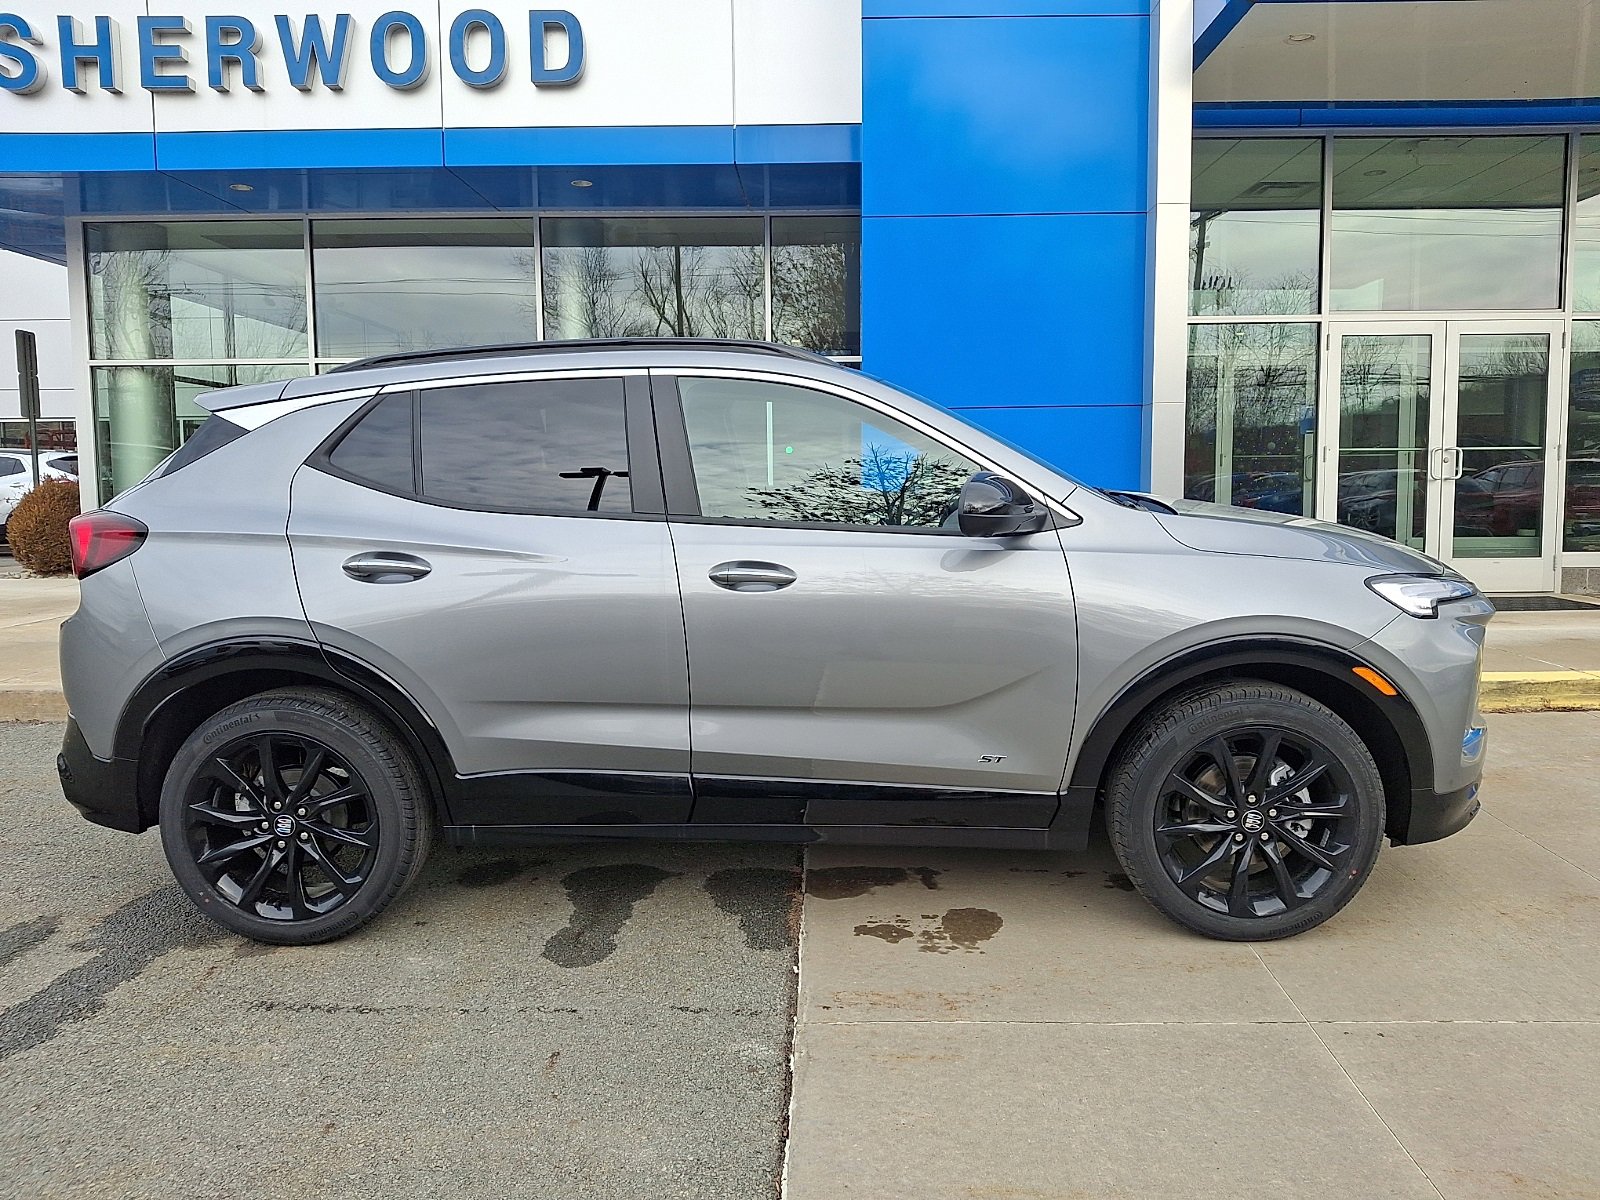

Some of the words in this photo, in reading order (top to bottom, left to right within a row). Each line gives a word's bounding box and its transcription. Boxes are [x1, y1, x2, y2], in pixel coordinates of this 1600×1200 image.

[0, 9, 588, 97] SHERWOOD
[203, 714, 252, 744] Continental
[978, 754, 1008, 763] ST
